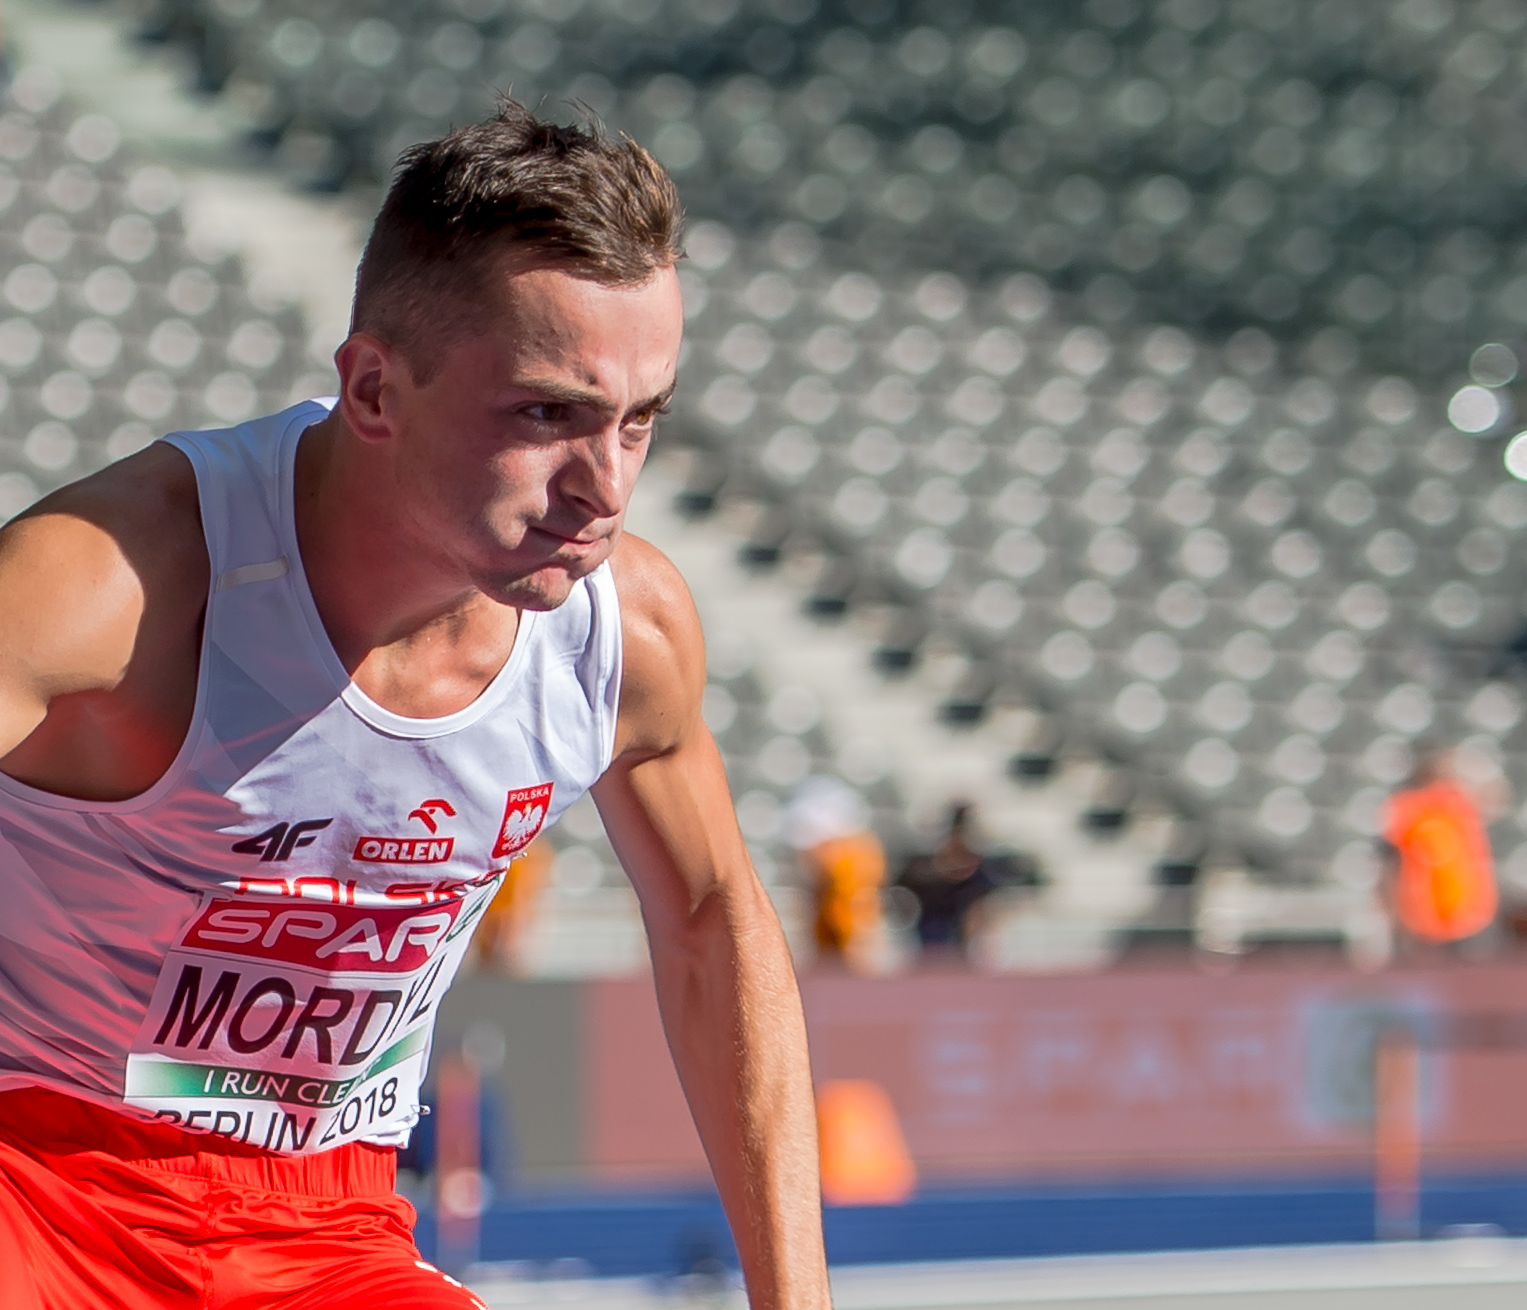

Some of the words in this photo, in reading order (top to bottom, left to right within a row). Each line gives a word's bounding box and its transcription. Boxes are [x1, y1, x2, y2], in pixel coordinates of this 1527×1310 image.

[509, 786, 550, 803] POLSKA
[360, 839, 449, 862] ORLEN
[195, 908, 453, 964] SPAR
[203, 1069, 216, 1094] I
[221, 1071, 291, 1098] RUN
[318, 1076, 399, 1147] 2018
